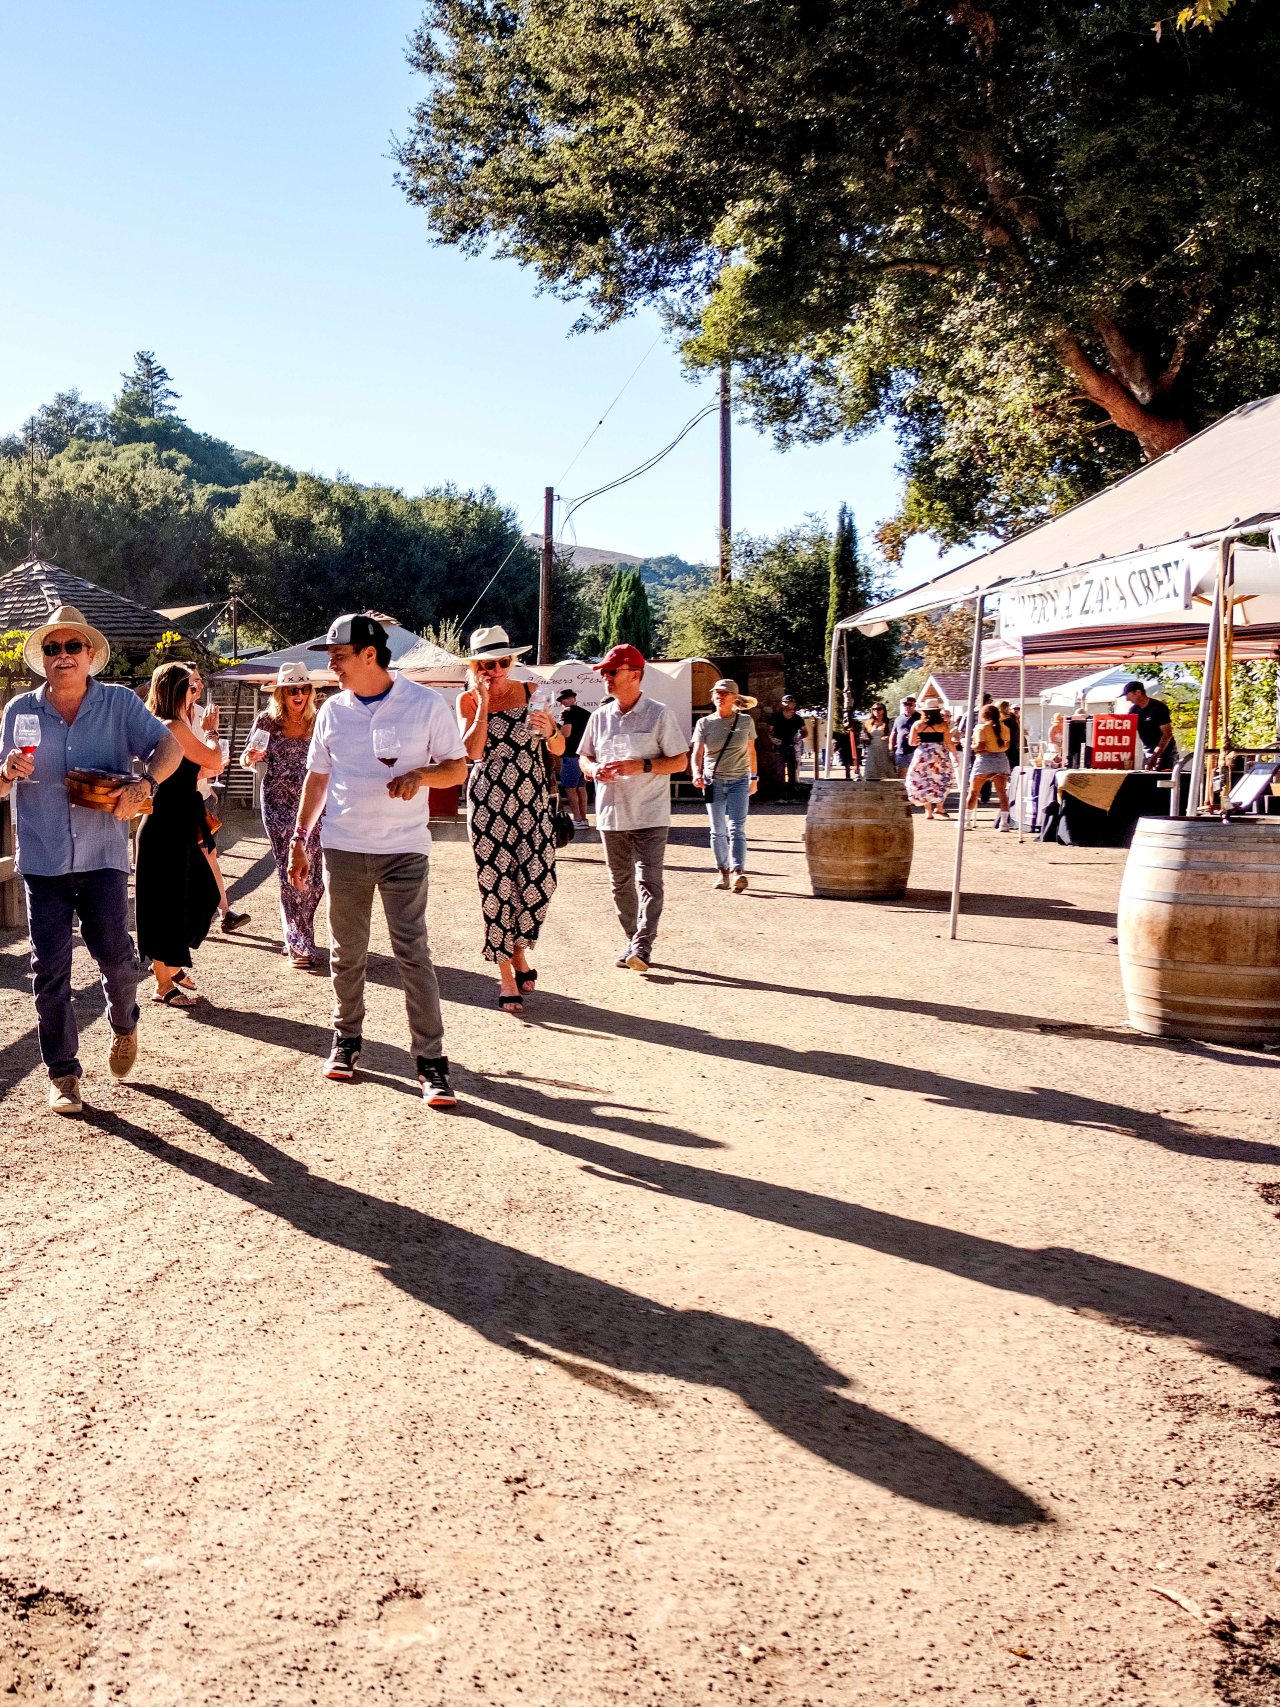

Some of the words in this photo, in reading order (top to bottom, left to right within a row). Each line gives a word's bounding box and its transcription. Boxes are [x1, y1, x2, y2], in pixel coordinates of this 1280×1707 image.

[1097, 719, 1132, 730] ZACA
[1097, 735, 1131, 746] COLD
[1094, 751, 1132, 762] BREW
